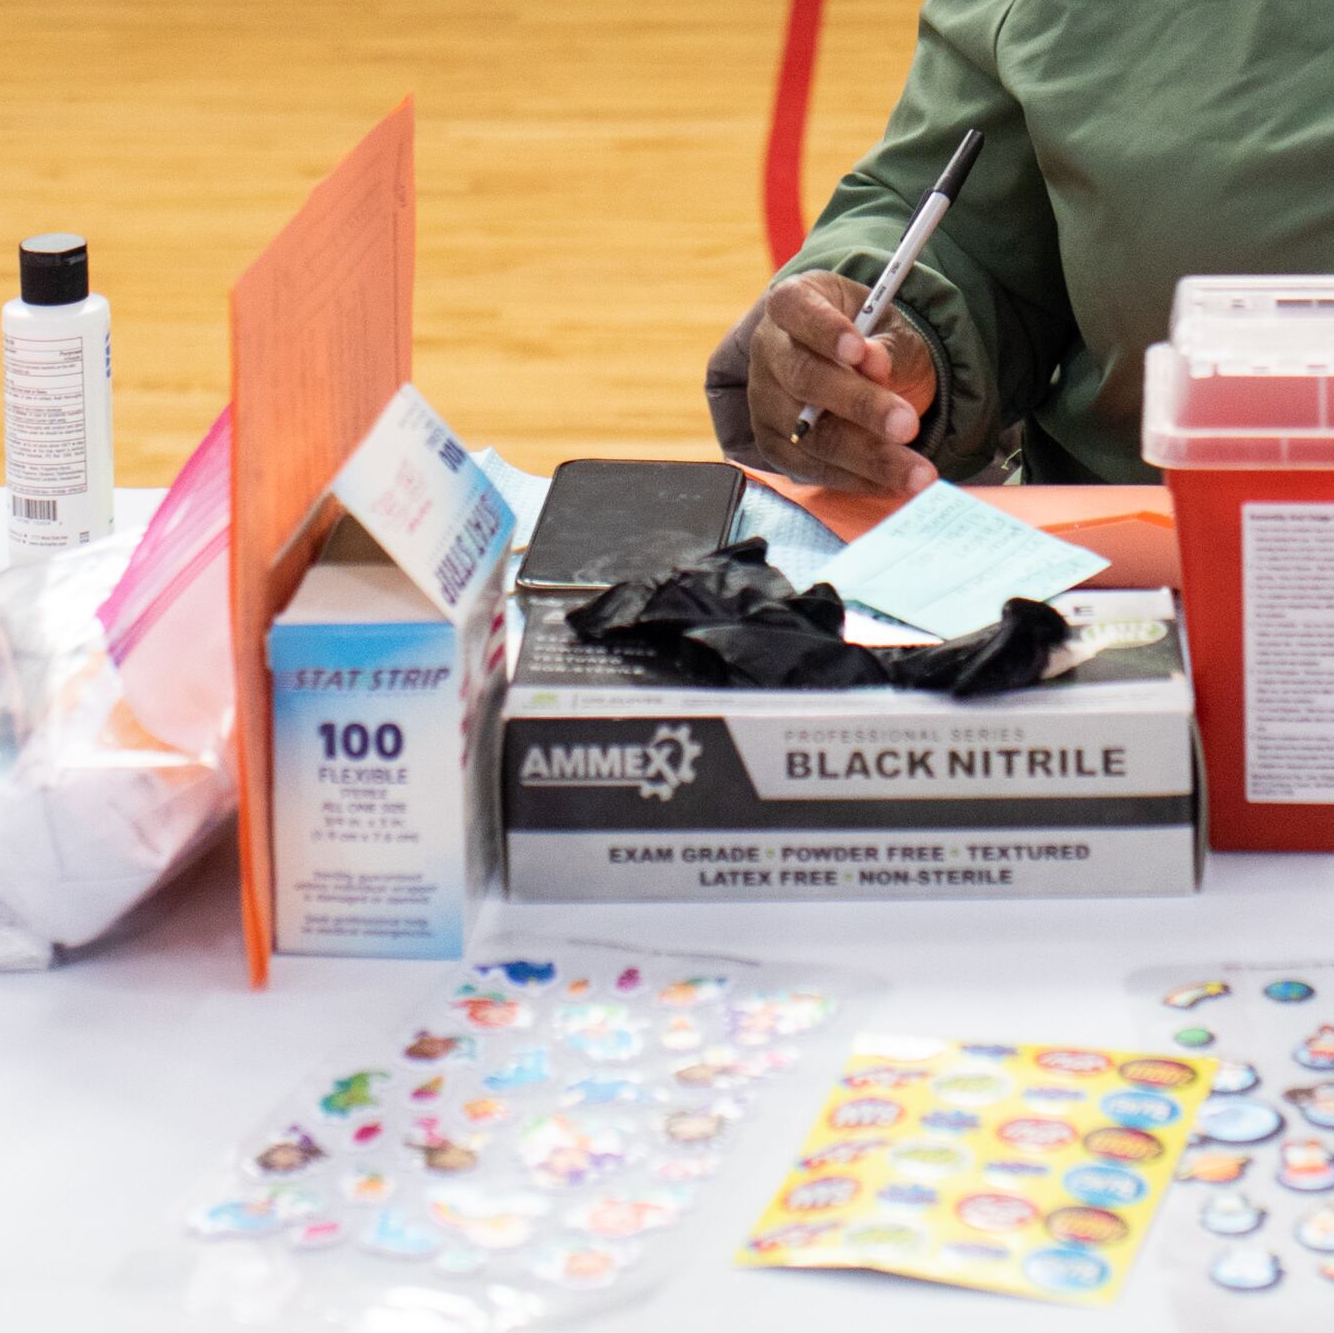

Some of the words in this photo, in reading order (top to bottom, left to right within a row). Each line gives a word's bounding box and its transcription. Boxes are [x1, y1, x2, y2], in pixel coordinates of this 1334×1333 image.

[295, 668, 363, 691] STAT
[371, 668, 451, 691] STRIP
[319, 722, 404, 760] 100
[783, 729, 940, 743] PROFESSIONAL
[950, 728, 1026, 743] SERIES
[520, 744, 679, 786] AMMEX
[785, 749, 937, 780] BLACK
[947, 747, 1129, 779] NITRILE
[318, 767, 409, 785] FLEXIBLE
[609, 846, 674, 863] EXAM
[681, 846, 761, 863] GRADE
[781, 846, 879, 863] POWDER
[886, 845, 945, 862] FREE
[967, 844, 1092, 861] TEXTURED
[699, 870, 772, 887] LATEX
[780, 870, 839, 887] FREE
[858, 868, 1014, 886] NON-STERILE
